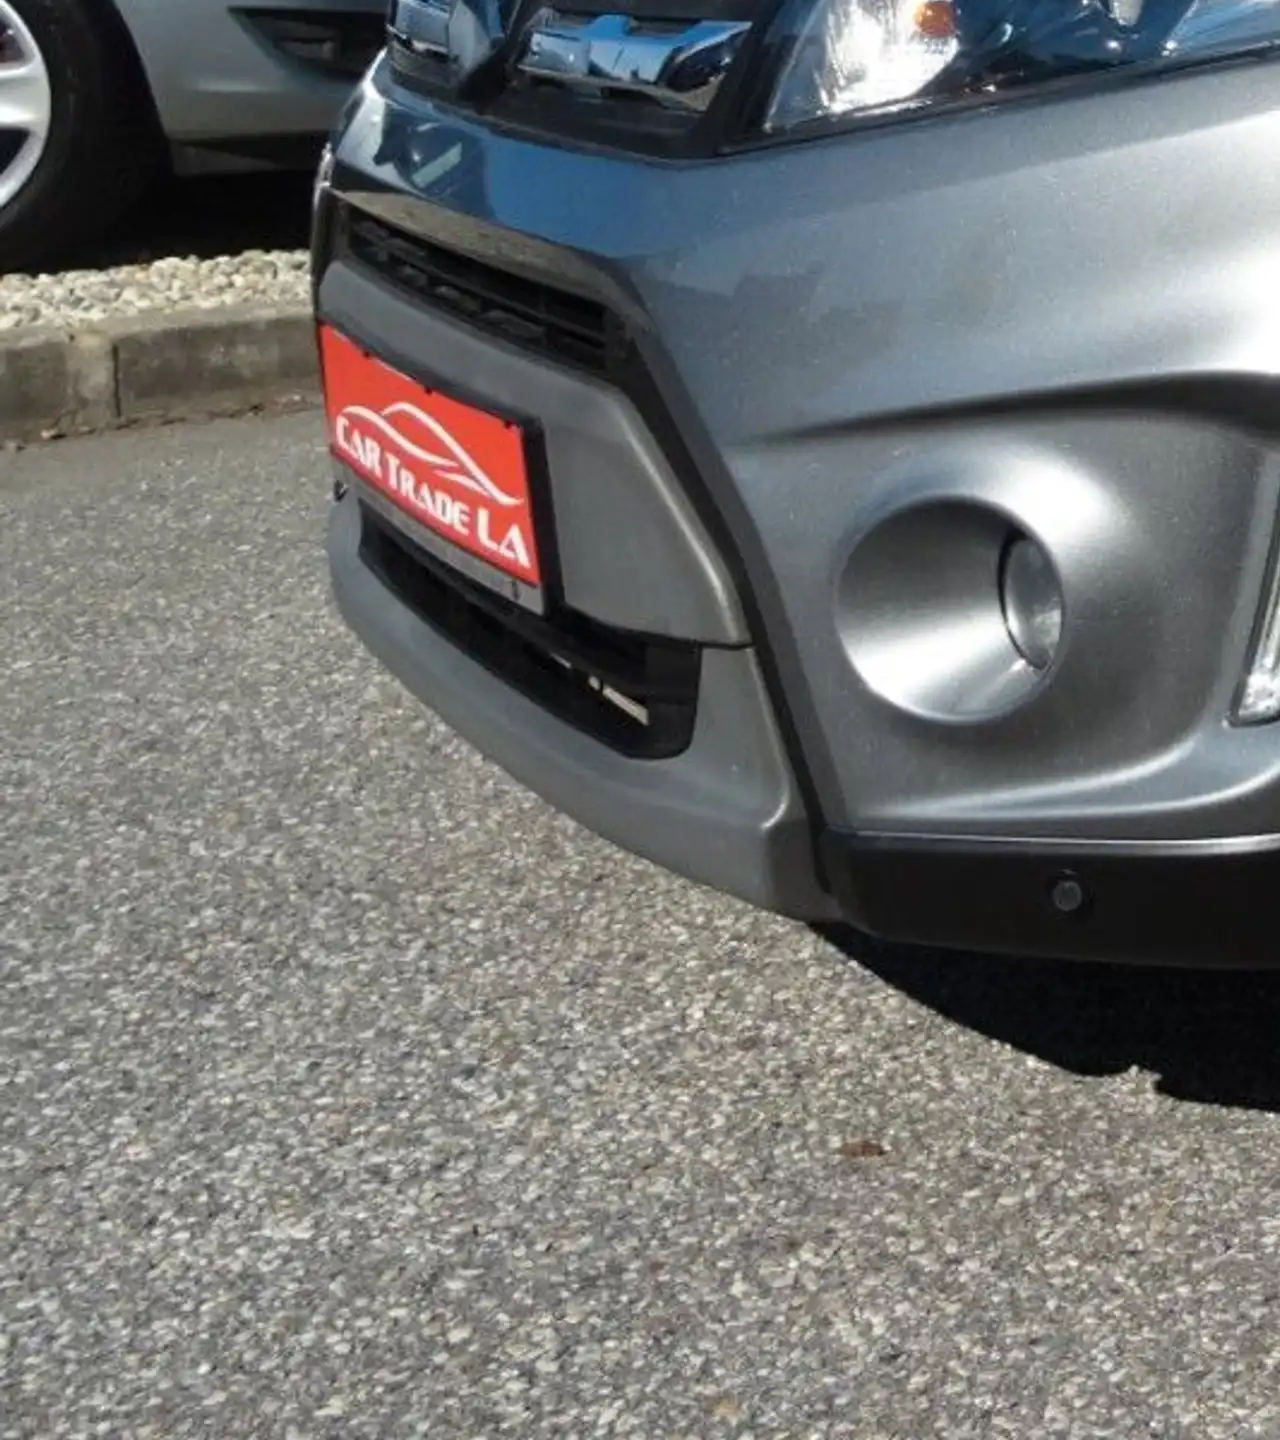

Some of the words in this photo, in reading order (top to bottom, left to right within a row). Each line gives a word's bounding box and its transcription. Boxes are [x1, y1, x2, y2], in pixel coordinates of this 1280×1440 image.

[336, 414, 382, 479] CAR
[384, 452, 471, 537] TRADE
[476, 507, 532, 570] LA
